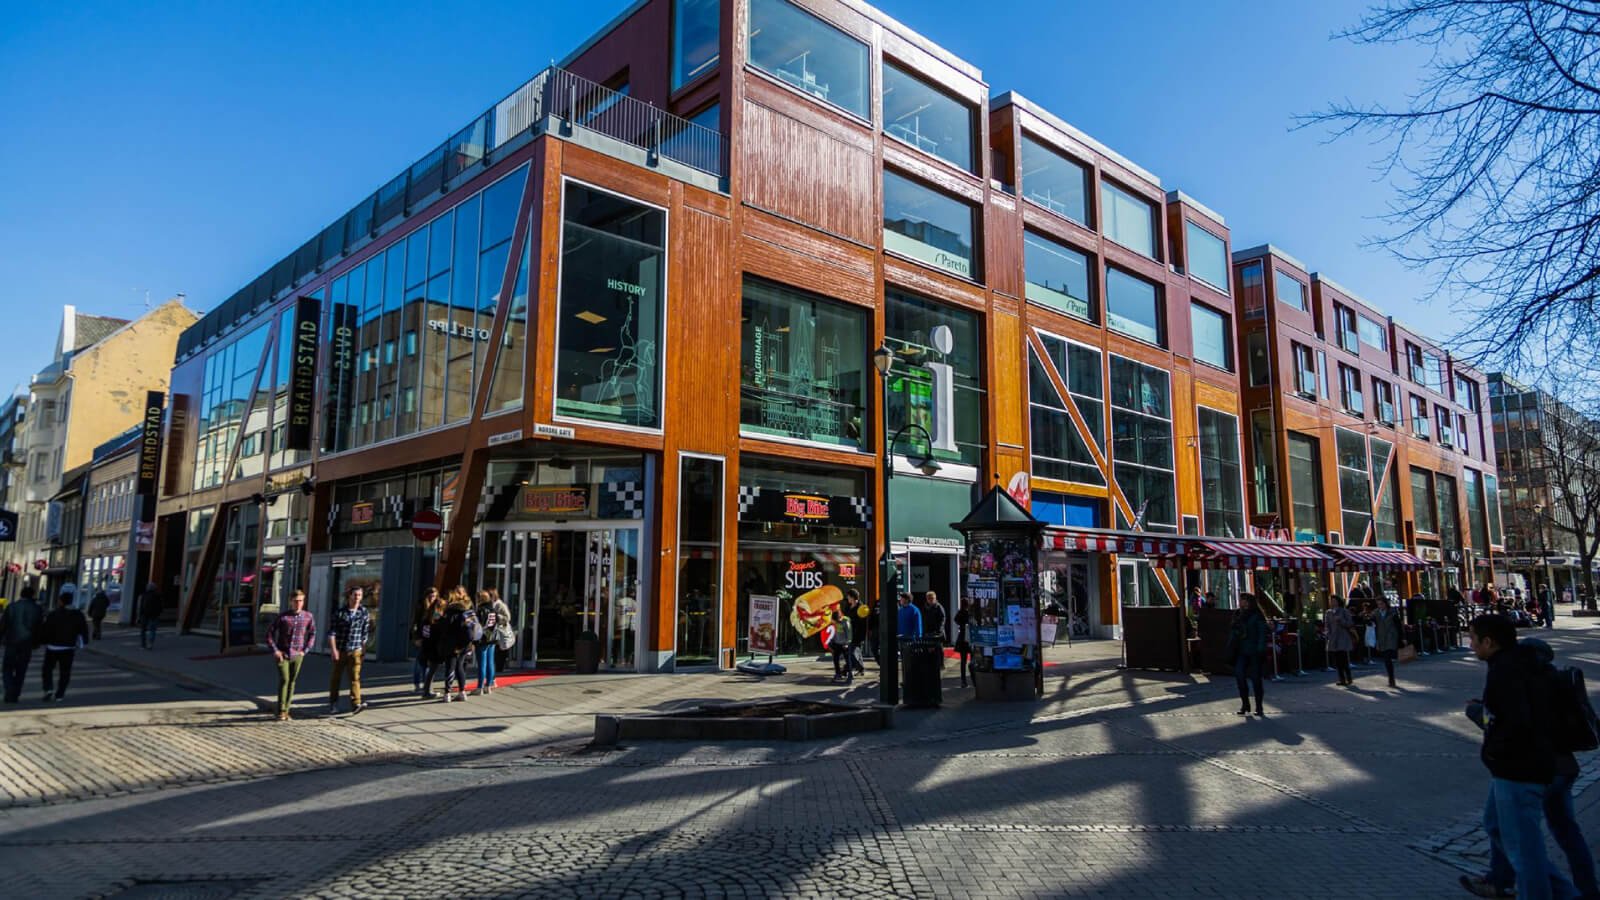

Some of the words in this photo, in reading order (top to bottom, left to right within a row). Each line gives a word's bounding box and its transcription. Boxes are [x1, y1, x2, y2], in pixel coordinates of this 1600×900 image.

[941, 253, 967, 272] Pareto
[607, 277, 646, 296] HISTORY
[754, 326, 762, 384] PILGRIMAGE
[293, 320, 316, 425] BRANDSTAD
[142, 406, 160, 479] BRANDSTAD
[786, 497, 805, 518] Big
[807, 499, 829, 516] Bite
[785, 570, 824, 589] SUBS
